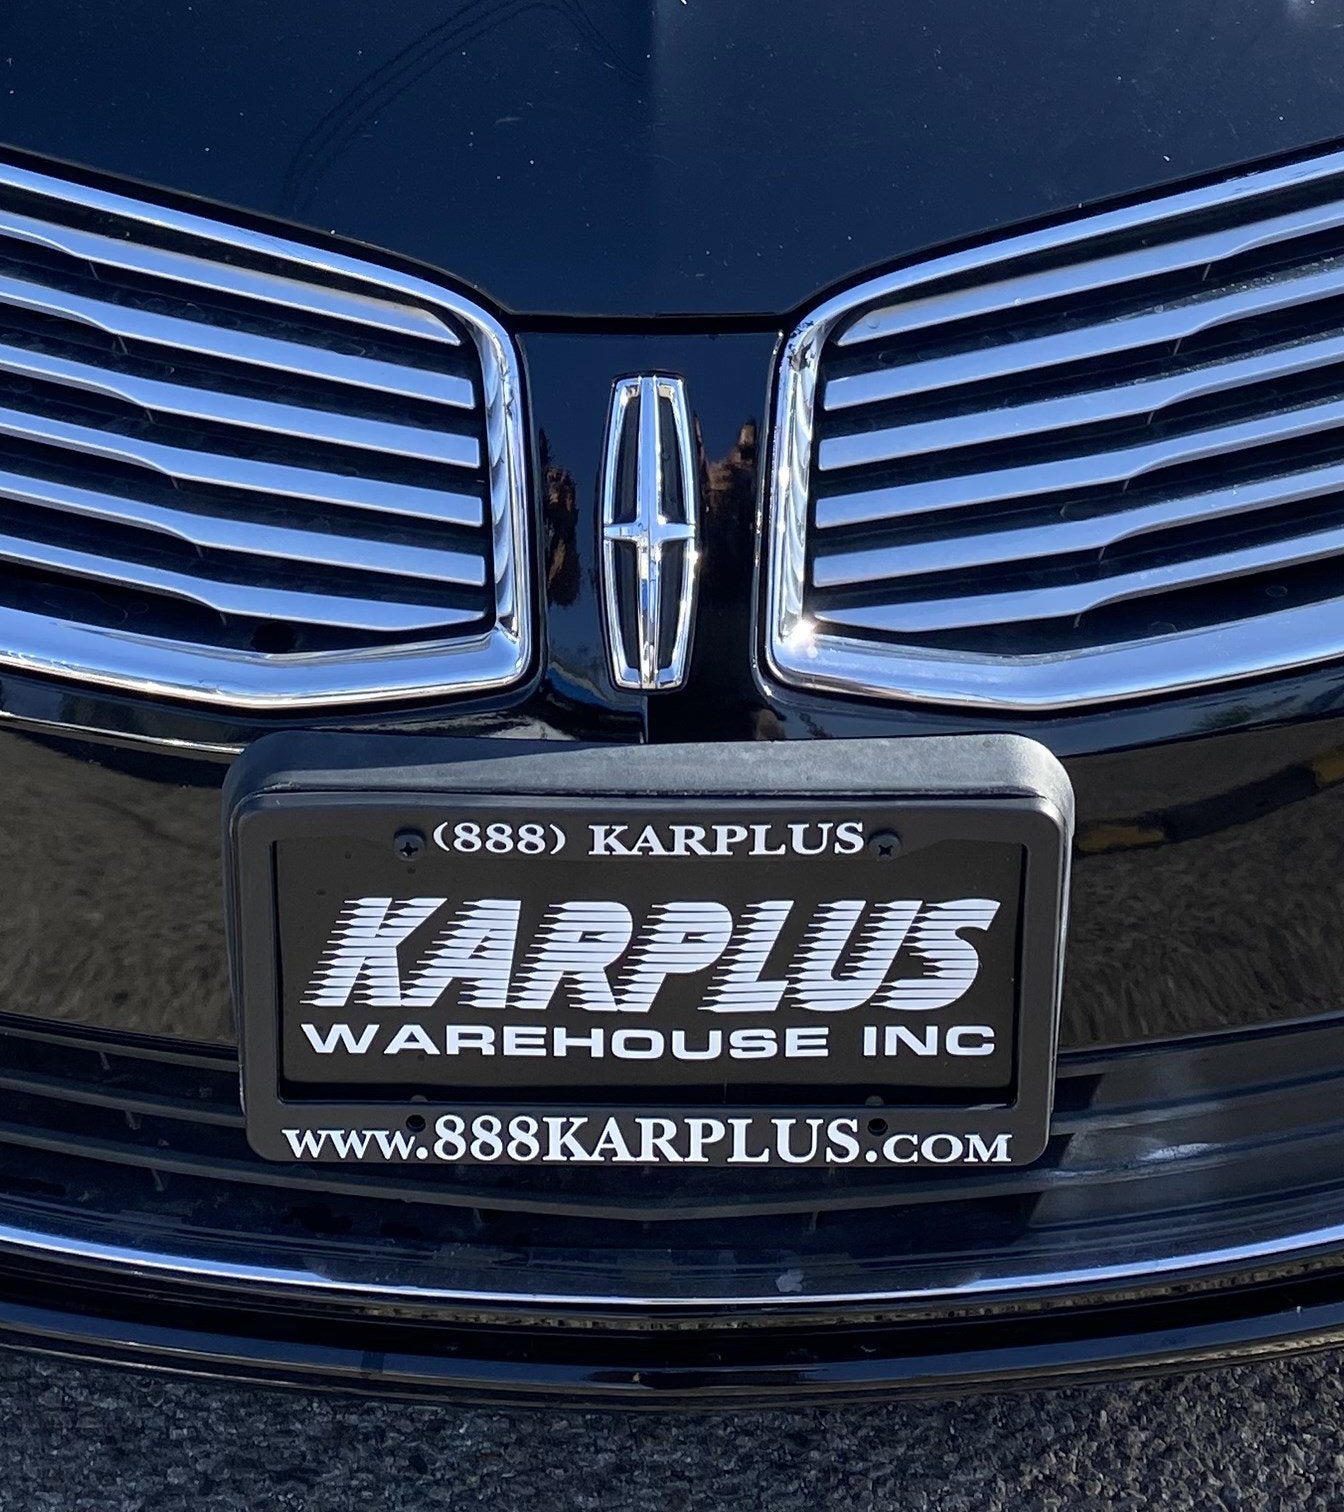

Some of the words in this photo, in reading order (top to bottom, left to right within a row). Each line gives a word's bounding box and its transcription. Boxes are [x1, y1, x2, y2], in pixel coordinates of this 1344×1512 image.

[432, 820, 567, 856] (888)
[587, 821, 865, 857] KARPLUS
[299, 896, 1002, 1014] KARPLUS
[300, 1023, 830, 1060] WAREHOUSE
[862, 1024, 996, 1057] INC
